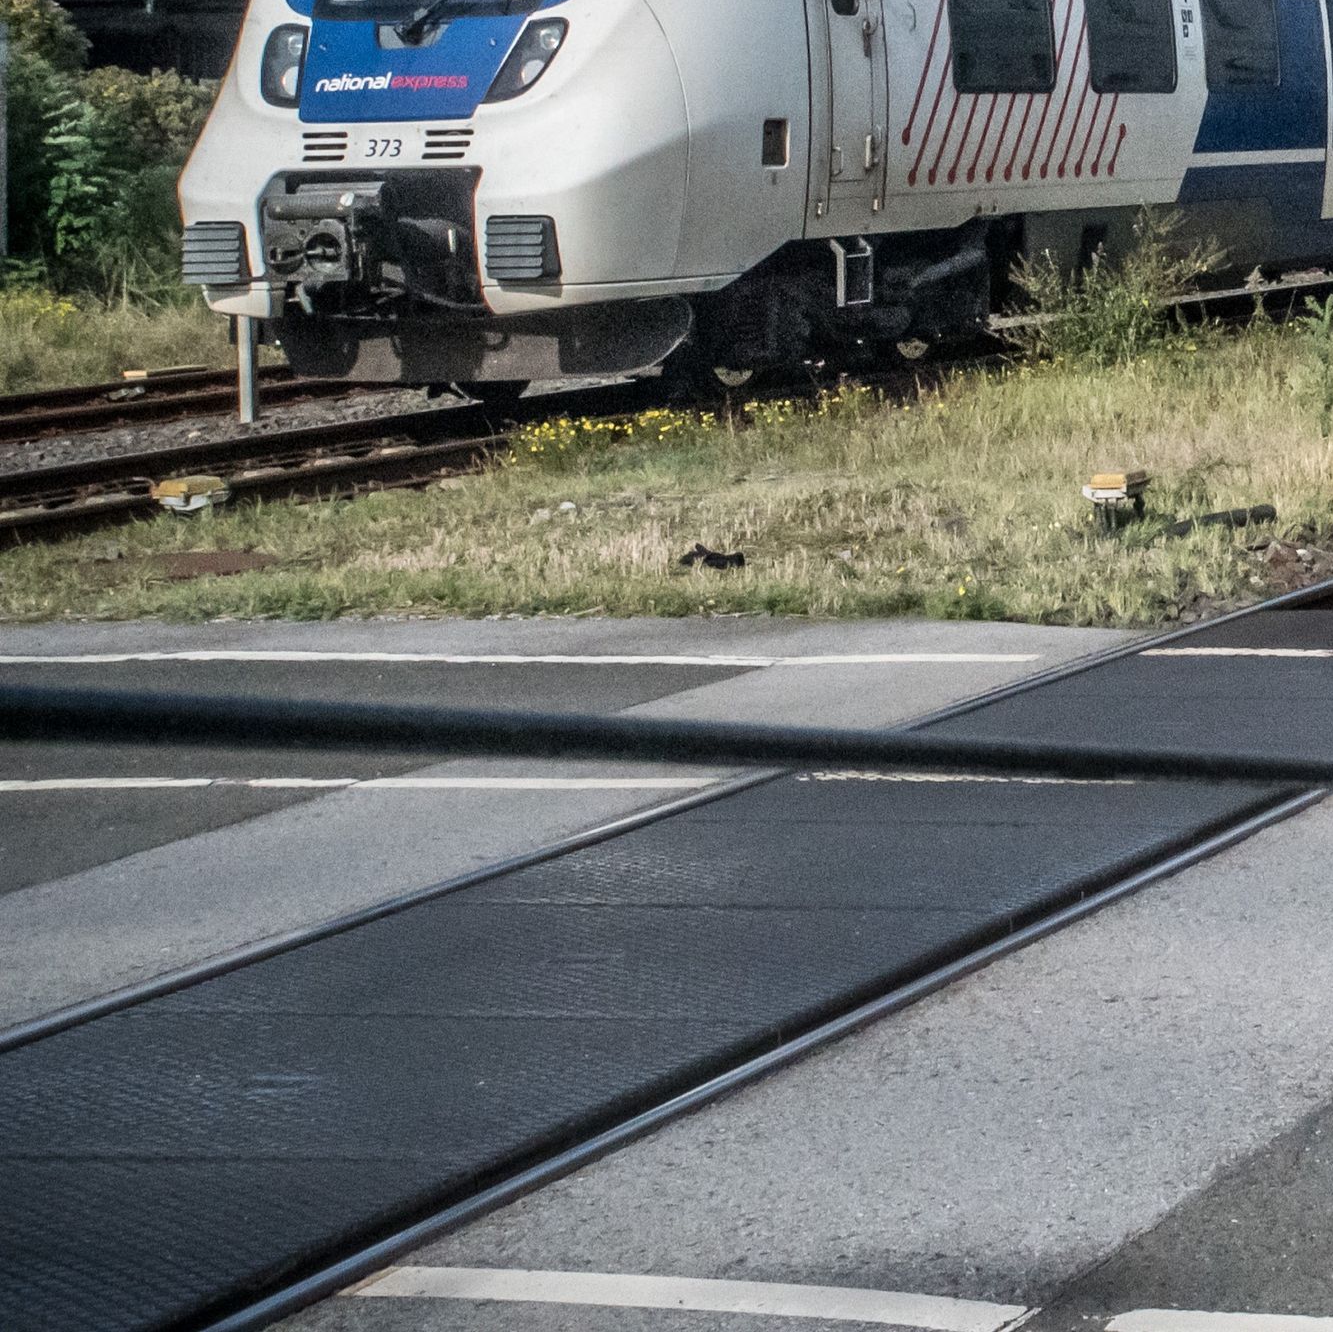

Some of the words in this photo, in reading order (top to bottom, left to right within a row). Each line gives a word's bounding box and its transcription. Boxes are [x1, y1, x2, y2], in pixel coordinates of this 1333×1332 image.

[315, 71, 393, 93] national
[391, 75, 469, 92] express
[365, 138, 402, 158] 373
